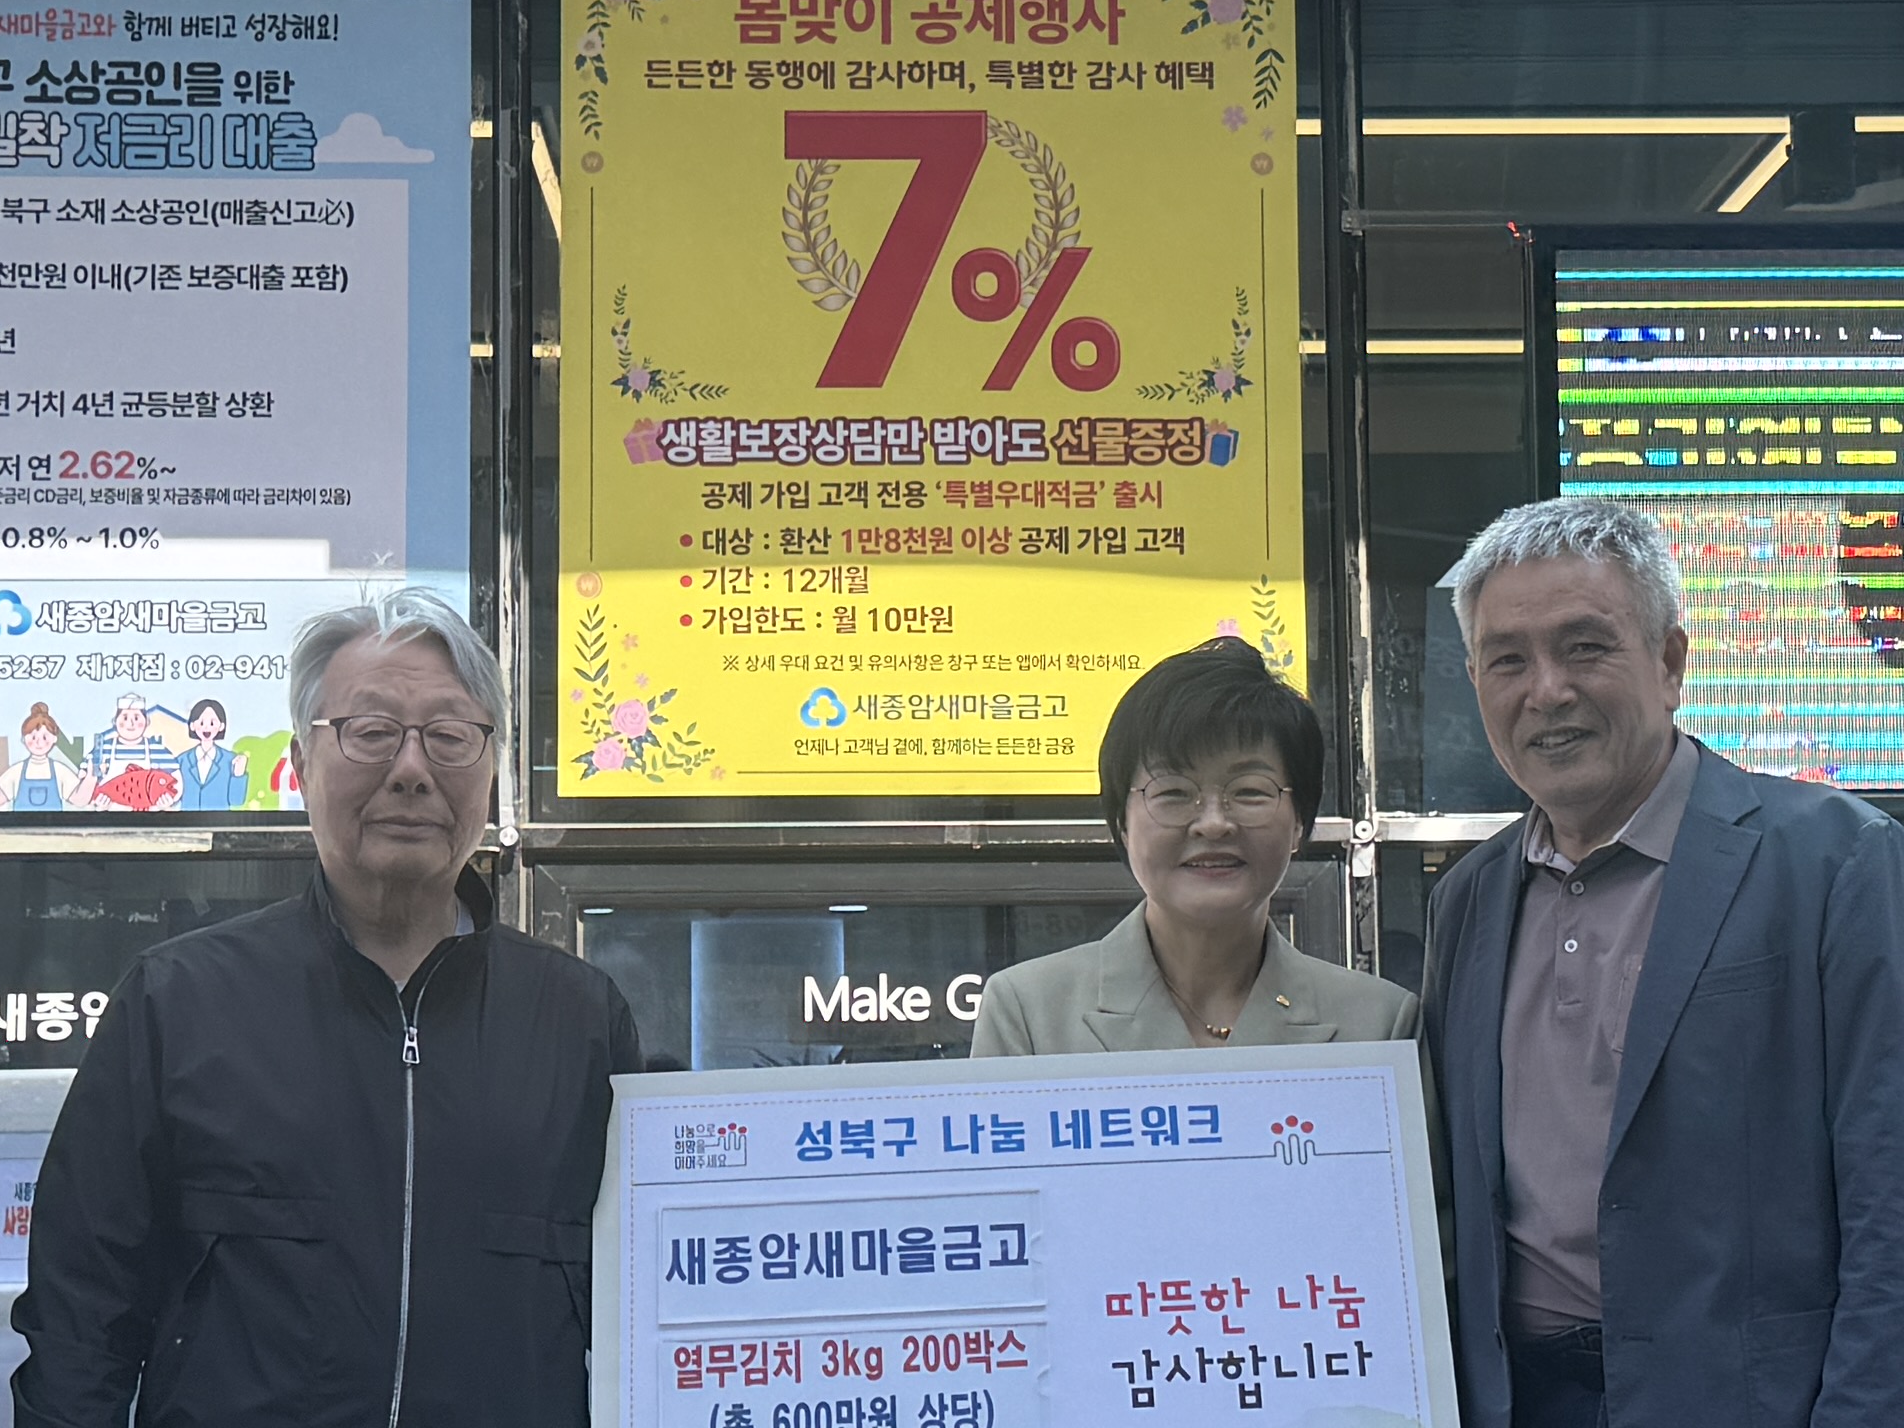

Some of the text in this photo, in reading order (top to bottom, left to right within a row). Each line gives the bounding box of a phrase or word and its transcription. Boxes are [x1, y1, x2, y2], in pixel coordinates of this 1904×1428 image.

[123, 10, 171, 41] 함께
[181, 15, 237, 38] 버티고
[245, 13, 338, 42] 성장해요!
[24, 60, 224, 107] 소상공인을
[234, 70, 295, 104] 위한
[644, 60, 1214, 93] 든든한 동행에 감사하며, 특별한 감사 혜택
[73, 112, 214, 170] 저금리
[223, 112, 317, 171] 대출
[56, 198, 105, 225] 소재
[784, 109, 1121, 392] 7%
[74, 264, 182, 292] 이내(기존
[187, 264, 285, 290] 보증대출
[291, 264, 348, 293] 포함)
[17, 391, 64, 417] 거치
[72, 391, 114, 417] 4년
[121, 391, 220, 417] 균등분할
[225, 391, 274, 418] 상환
[661, 416, 1205, 466] 생활보장상담만 받아도 선물증정
[28, 454, 51, 481] 연
[34, 488, 86, 506] CD금리,
[147, 488, 160, 505] 및
[234, 488, 260, 505] 따라
[320, 488, 351, 506] 있음)
[702, 482, 751, 509] 공제
[760, 481, 809, 509] 가입
[818, 481, 868, 508] 고객
[877, 481, 927, 508] 전용
[1113, 481, 1162, 509] 출시
[2, 527, 67, 548] 0.8%
[99, 527, 159, 549] 1.0%
[703, 526, 1184, 556] 대상 환산 1만8천원 이상 공제 가입 고객
[703, 566, 868, 594] 기간 12개월
[35, 600, 267, 634] 새종암새마을금고
[702, 606, 953, 634] 가입한도 월 10만원
[76, 652, 165, 682] 제1지점
[746, 655, 774, 672] 상세
[780, 655, 809, 671] 우대
[814, 655, 843, 671] 요건
[849, 655, 862, 671] 및
[868, 655, 944, 671] 유의사항은
[948, 655, 977, 671] 창구
[982, 655, 1012, 671] 또는
[1016, 654, 1060, 671] 앱에서
[853, 694, 1068, 720] 새종암새마을금고
[795, 738, 839, 755] 언제나
[844, 738, 888, 755] 고객님
[932, 738, 992, 755] 함께하는
[996, 738, 1041, 755] 든든한
[1045, 738, 1075, 755] 금융
[805, 973, 931, 1022] Make
[795, 1105, 1222, 1161] 성북구 나눔 네트워크
[666, 1223, 1028, 1285] 새종암새마을금고
[1106, 1275, 1365, 1335] 따뜻한 나눔
[674, 1329, 1029, 1389] 열무김치 3kg 200박스
[1112, 1341, 1372, 1409] 감사합니다
